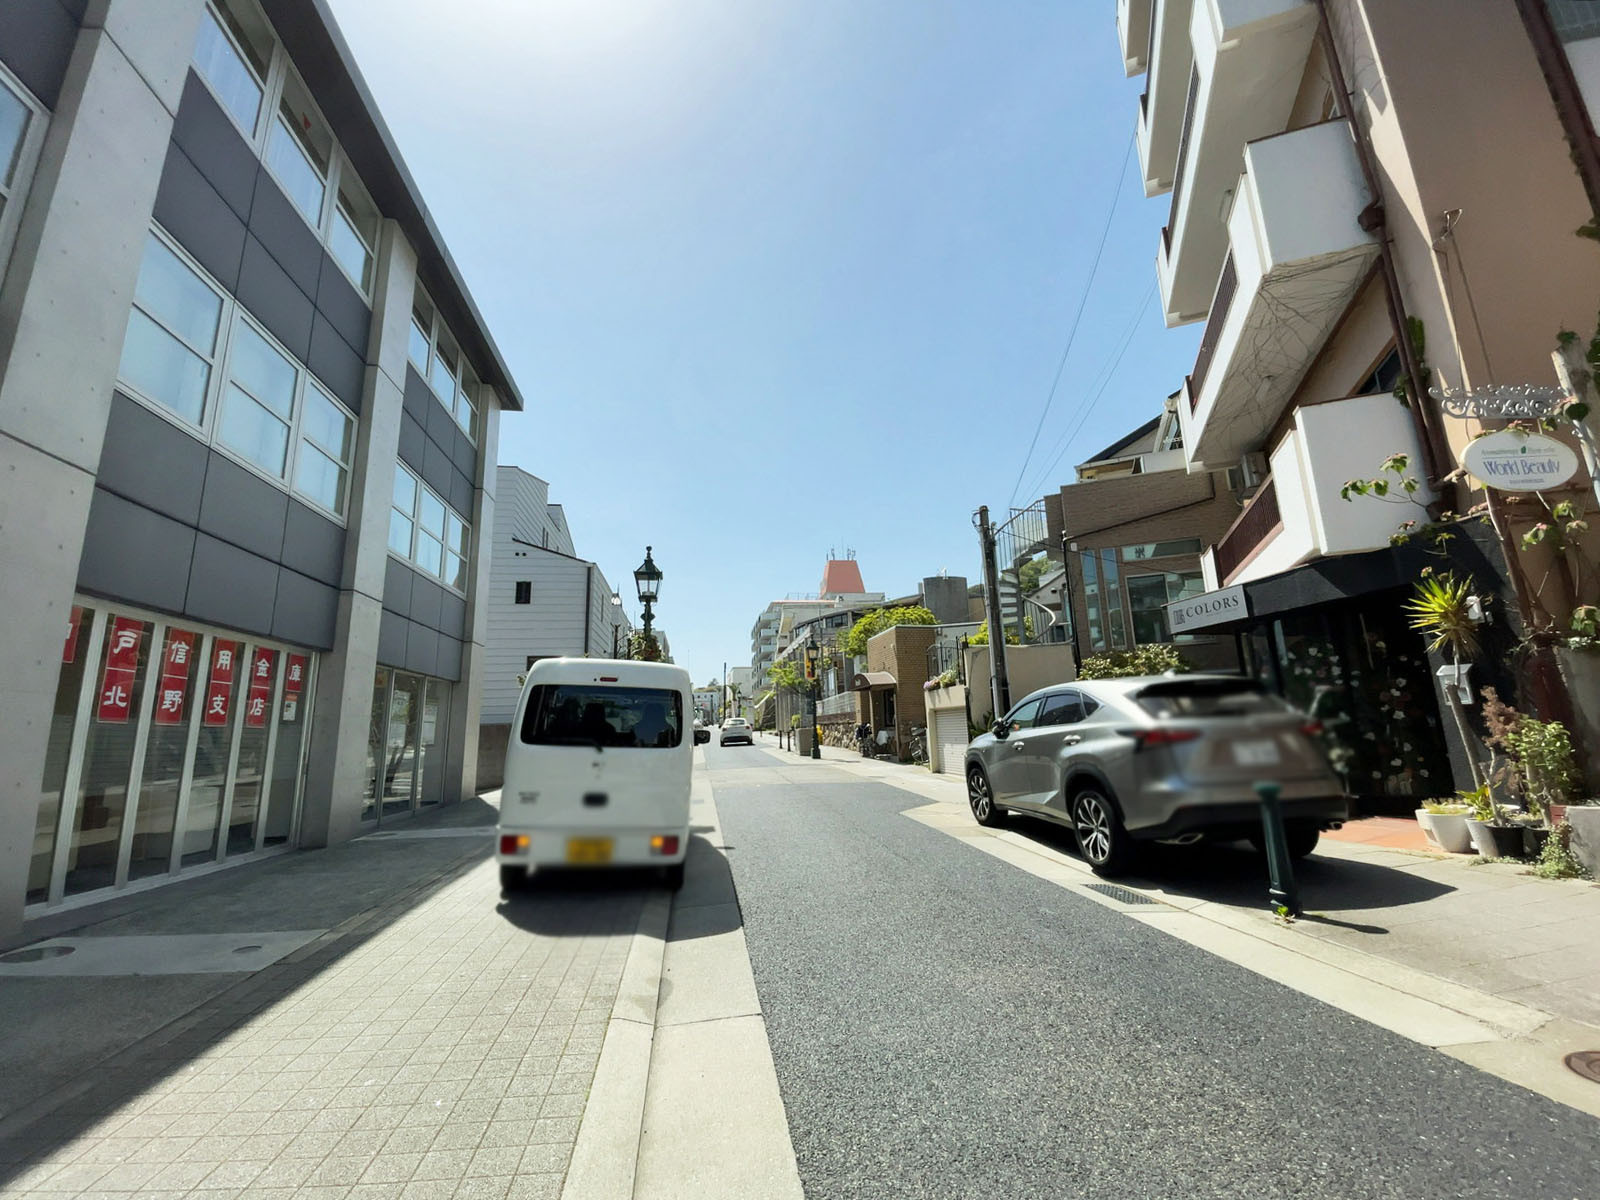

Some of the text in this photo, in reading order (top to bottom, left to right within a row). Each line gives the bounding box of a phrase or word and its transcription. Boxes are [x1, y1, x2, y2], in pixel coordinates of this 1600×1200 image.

[1483, 458, 1560, 476] World Beauty
[1185, 595, 1239, 618] COLORS
[103, 685, 265, 716] 北野支店
